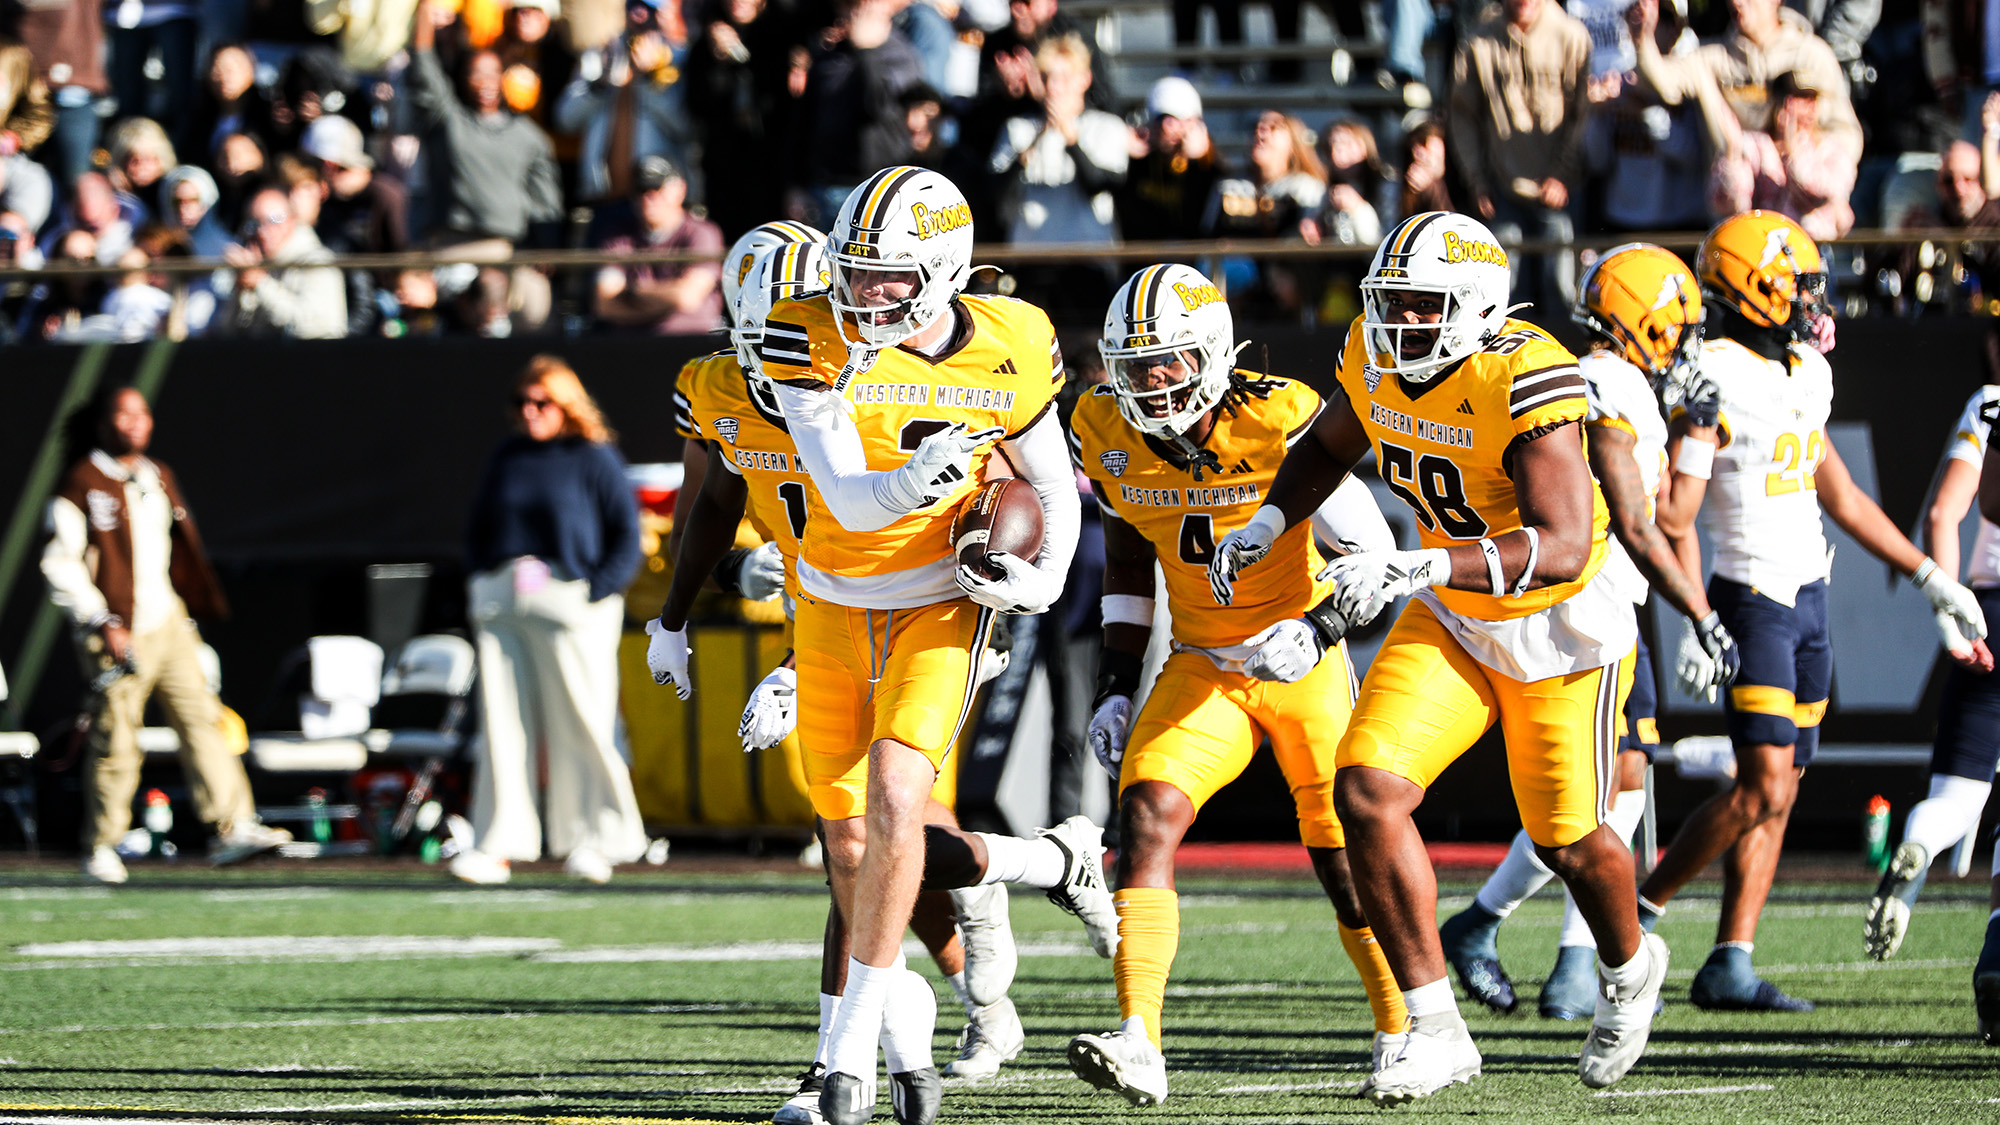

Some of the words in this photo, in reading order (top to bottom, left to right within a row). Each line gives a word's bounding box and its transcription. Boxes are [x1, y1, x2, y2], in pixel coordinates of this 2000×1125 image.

[848, 243, 870, 257] EAT
[1129, 335, 1151, 347] EAT
[834, 364, 855, 392] NXTRND
[854, 382, 930, 406] WESTERN
[934, 384, 1016, 411] MICHIGAN
[1369, 401, 1413, 436] WESTERN
[1417, 418, 1473, 449] MICHIGAN
[1102, 457, 1128, 467] MAC
[1119, 483, 1181, 507] WESTERN
[1186, 483, 1260, 507] MICHIGAN
[1378, 438, 1490, 540] 58
[1178, 513, 1239, 582] 4
